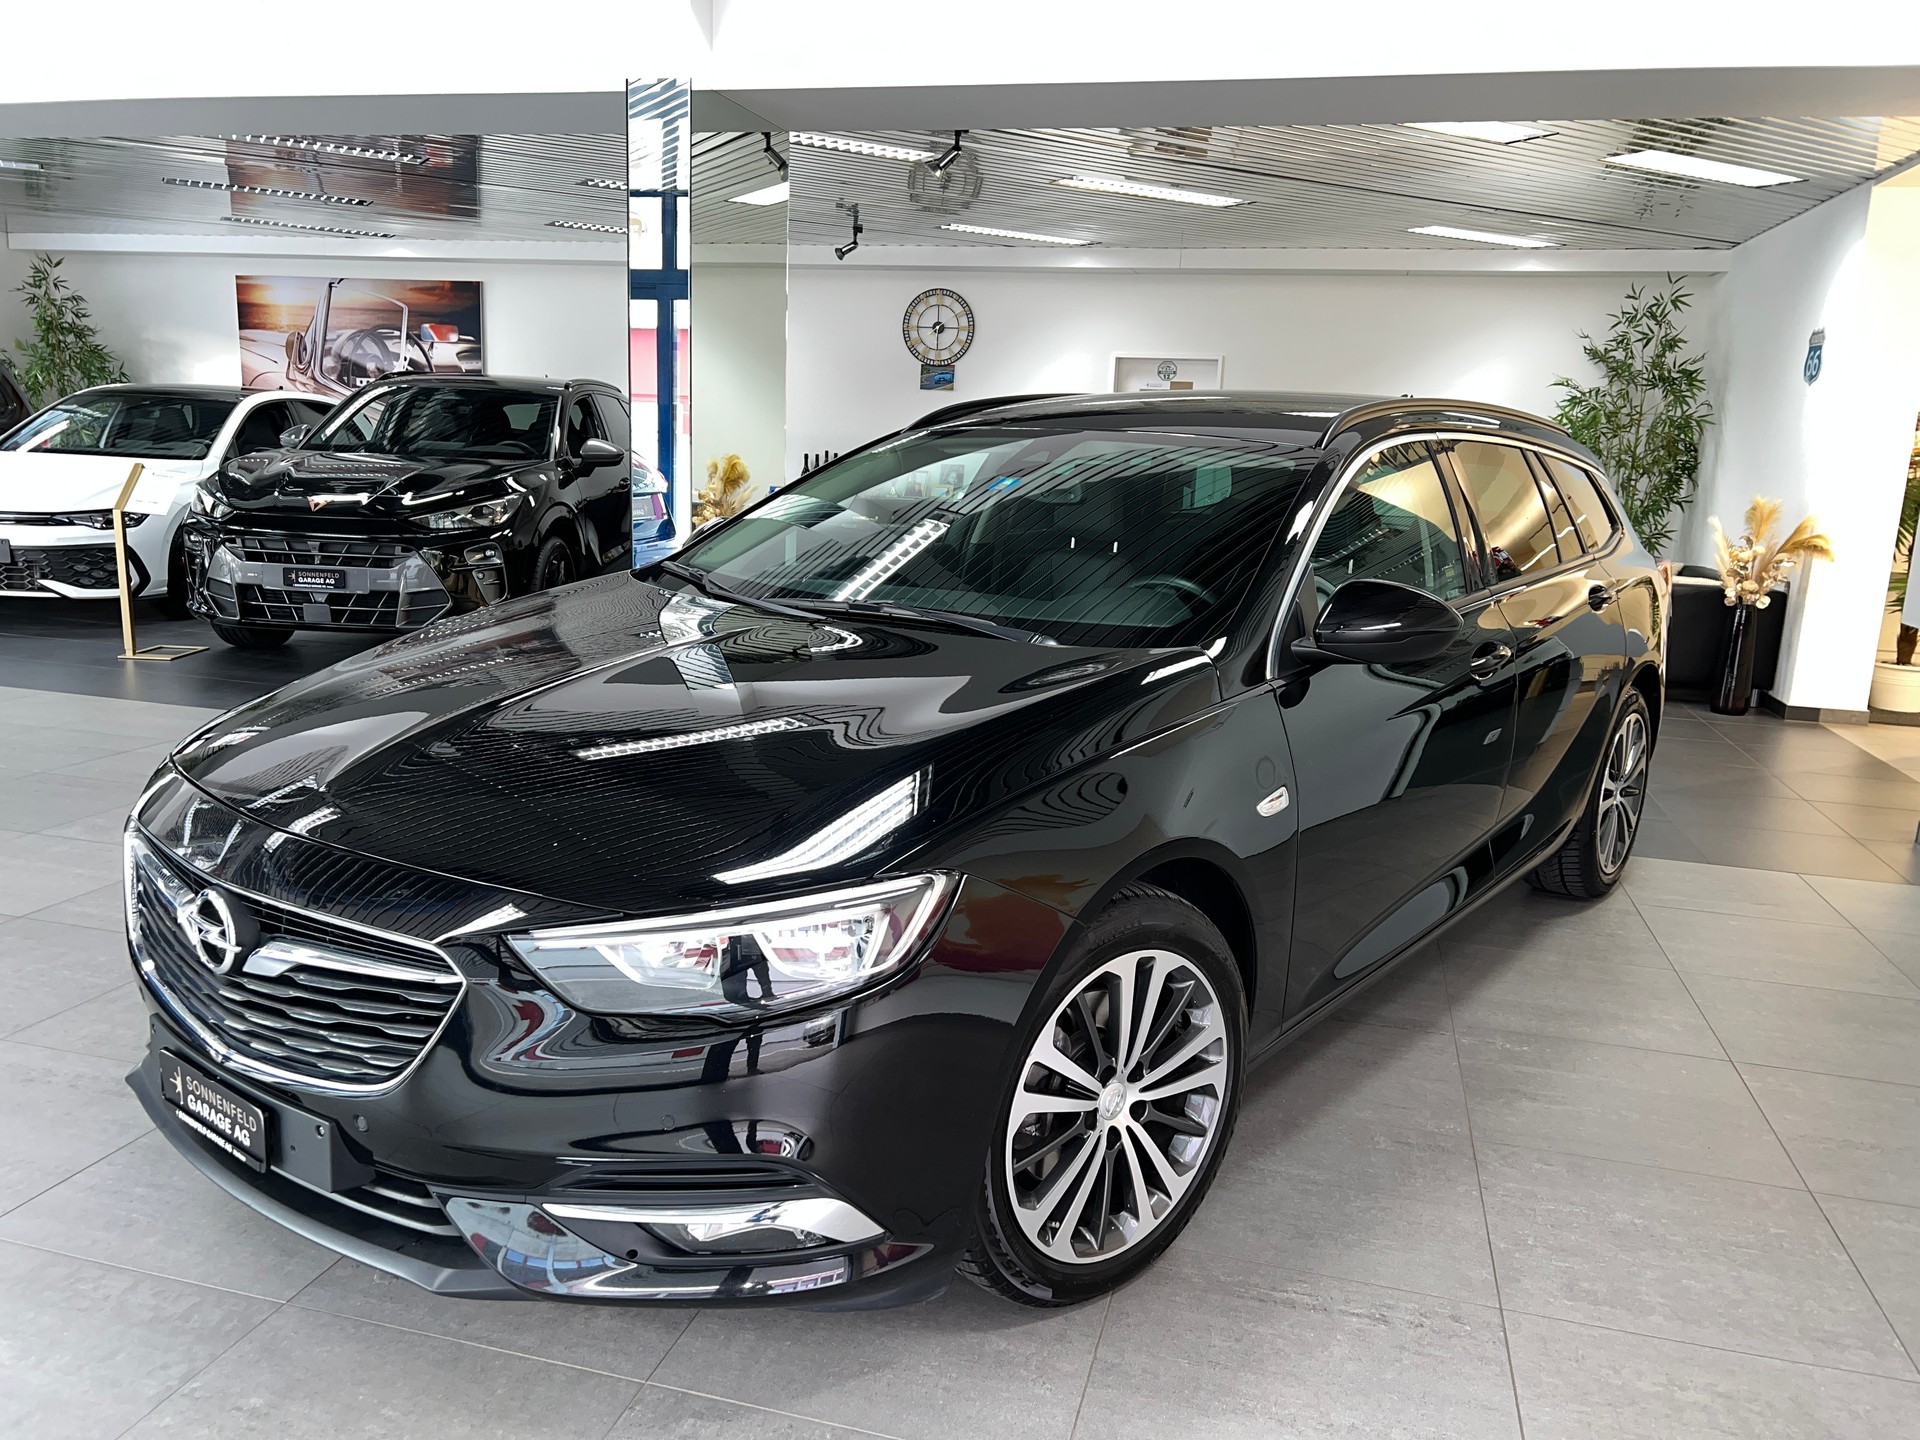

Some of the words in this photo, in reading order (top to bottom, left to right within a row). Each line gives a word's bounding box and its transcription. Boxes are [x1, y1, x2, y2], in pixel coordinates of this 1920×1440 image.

[1806, 350, 1820, 376] 66
[298, 571, 340, 579] SONNENFELD
[186, 1076, 257, 1132] SONNENFELD
[187, 1094, 232, 1134] GARAGE
[234, 1124, 251, 1147] AG
